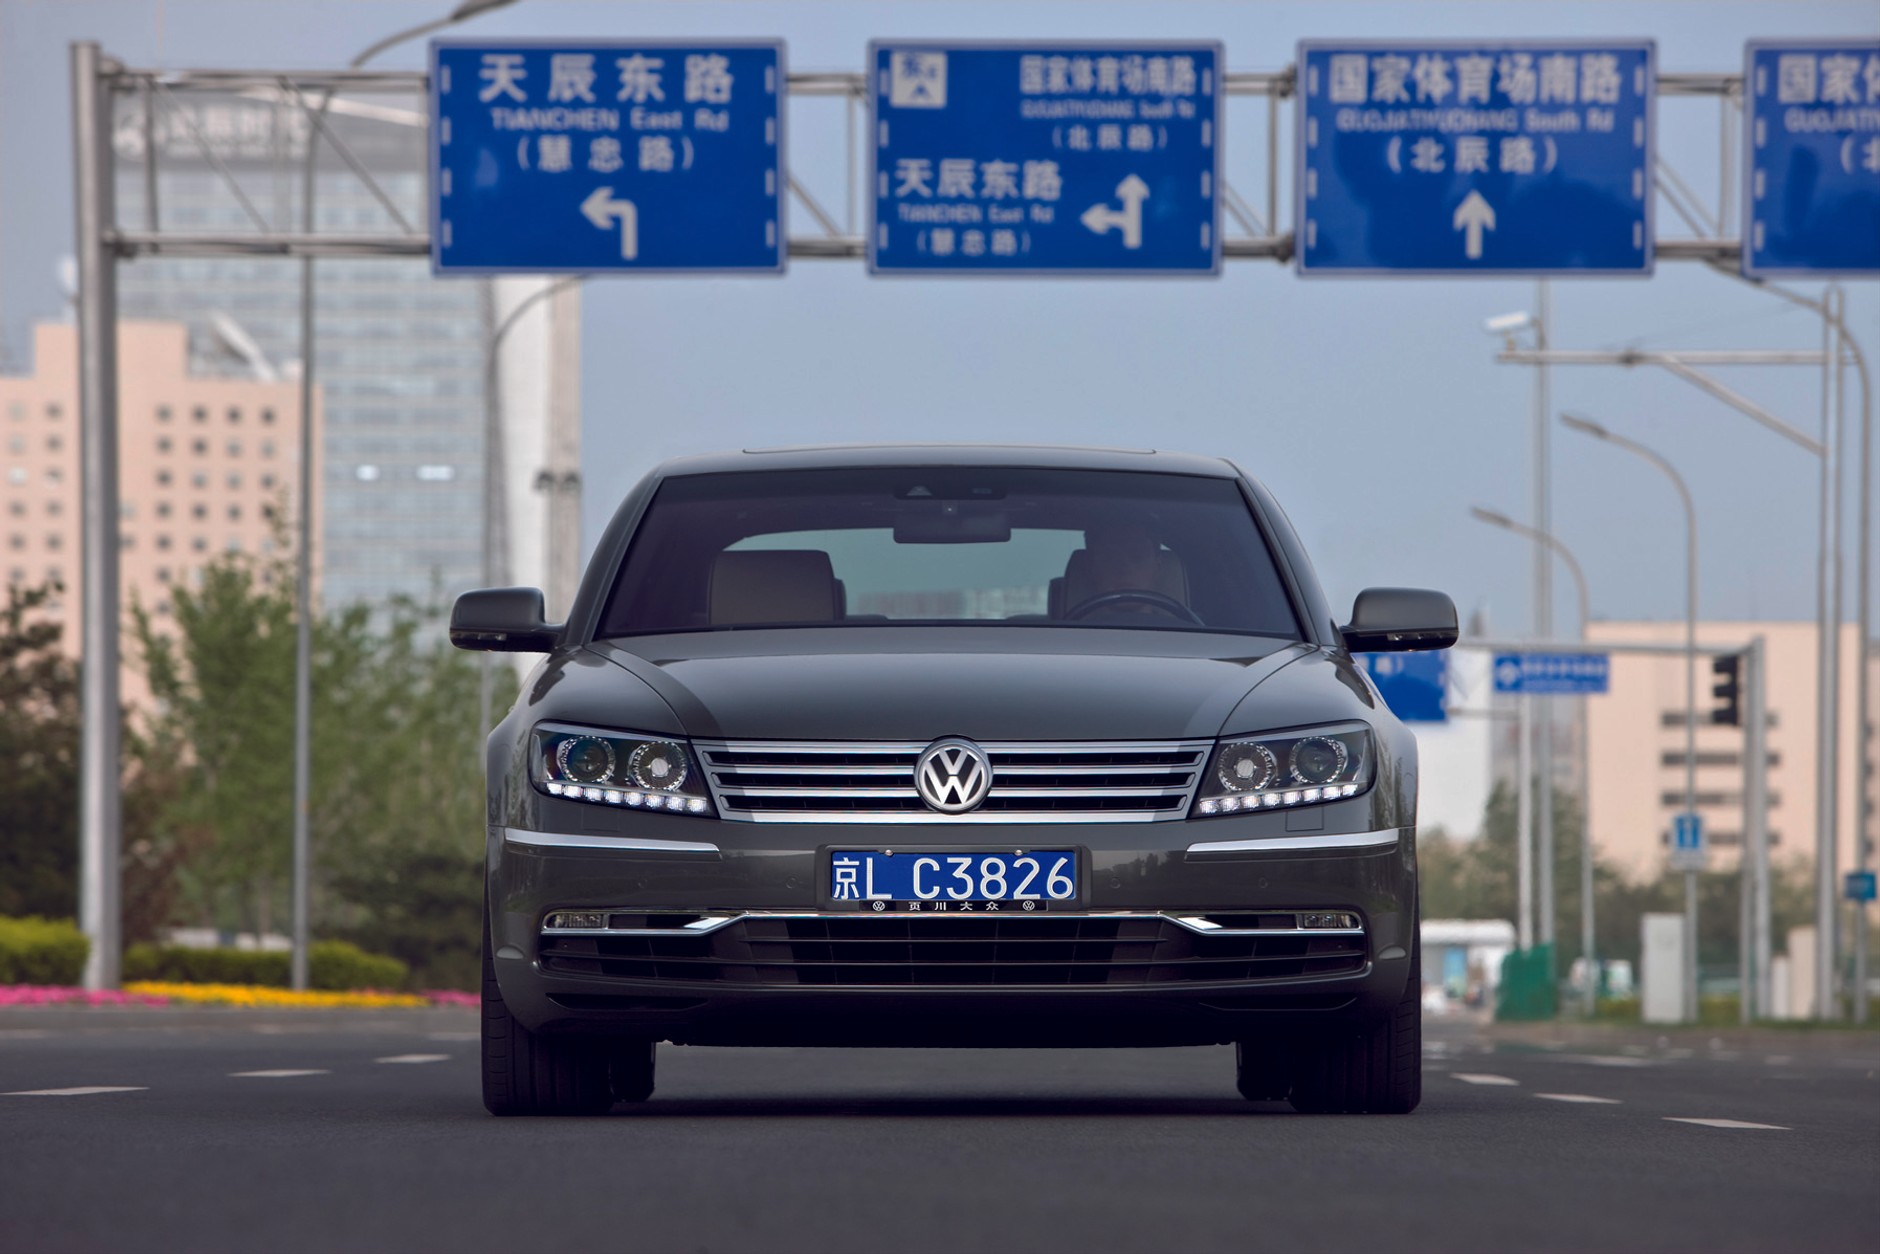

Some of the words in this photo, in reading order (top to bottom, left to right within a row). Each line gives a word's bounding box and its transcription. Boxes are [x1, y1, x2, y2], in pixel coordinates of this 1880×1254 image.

[479, 53, 734, 104] 天辰东路
[1328, 52, 1622, 104] 国家体育场南路
[490, 107, 621, 131] TIANCHEN
[629, 106, 683, 130] East
[694, 107, 730, 132] Rd
[895, 157, 1063, 202] 天辰东路
[913, 857, 1074, 900] C3826
